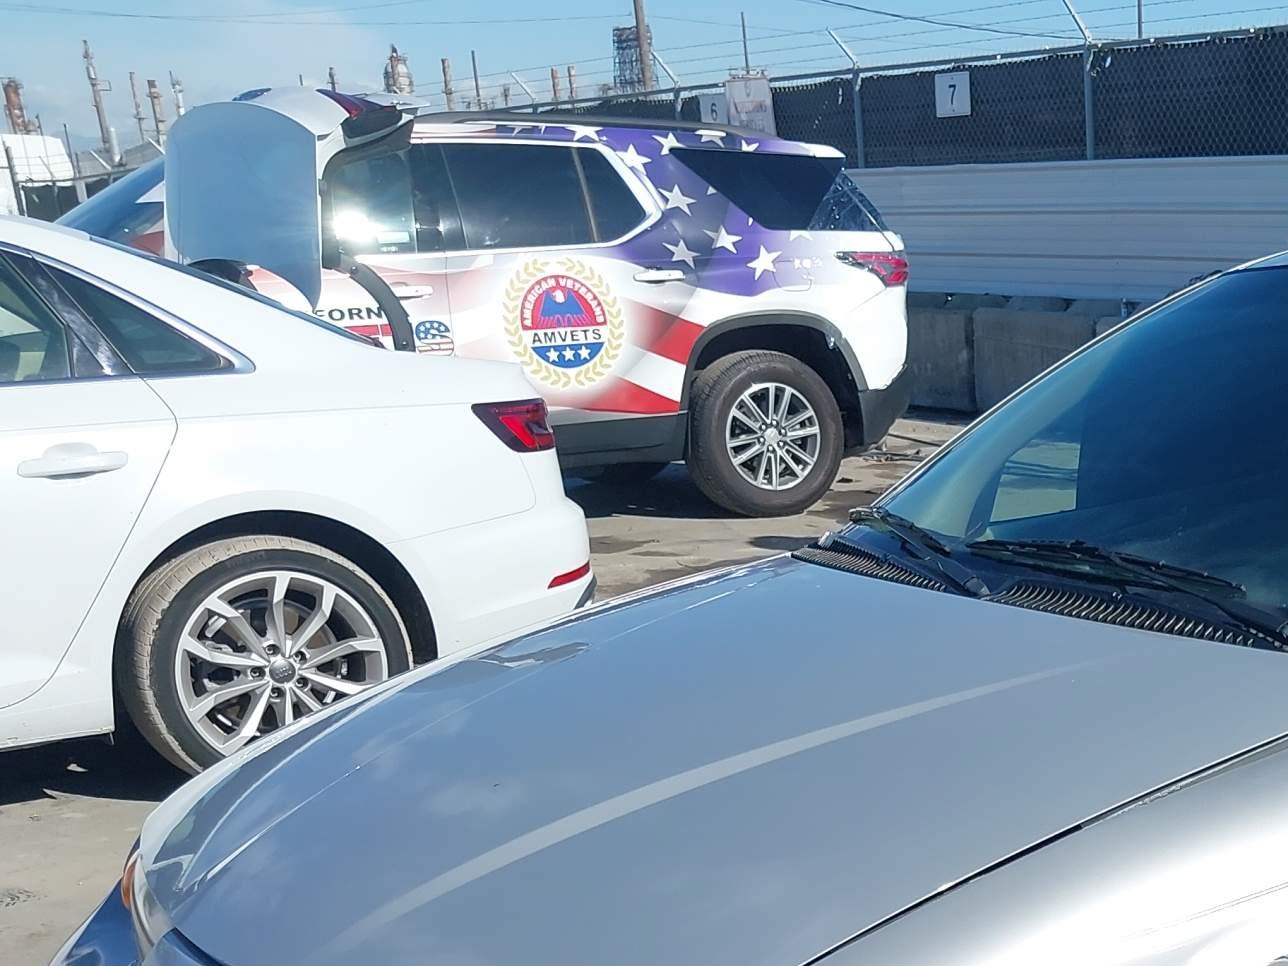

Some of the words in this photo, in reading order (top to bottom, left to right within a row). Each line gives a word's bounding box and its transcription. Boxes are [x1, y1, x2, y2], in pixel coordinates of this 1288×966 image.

[949, 84, 957, 105] 7
[711, 102, 718, 121] 6
[522, 278, 557, 327] AMERICAN
[558, 277, 604, 323] VETERANS
[532, 328, 602, 344] AMVETS
